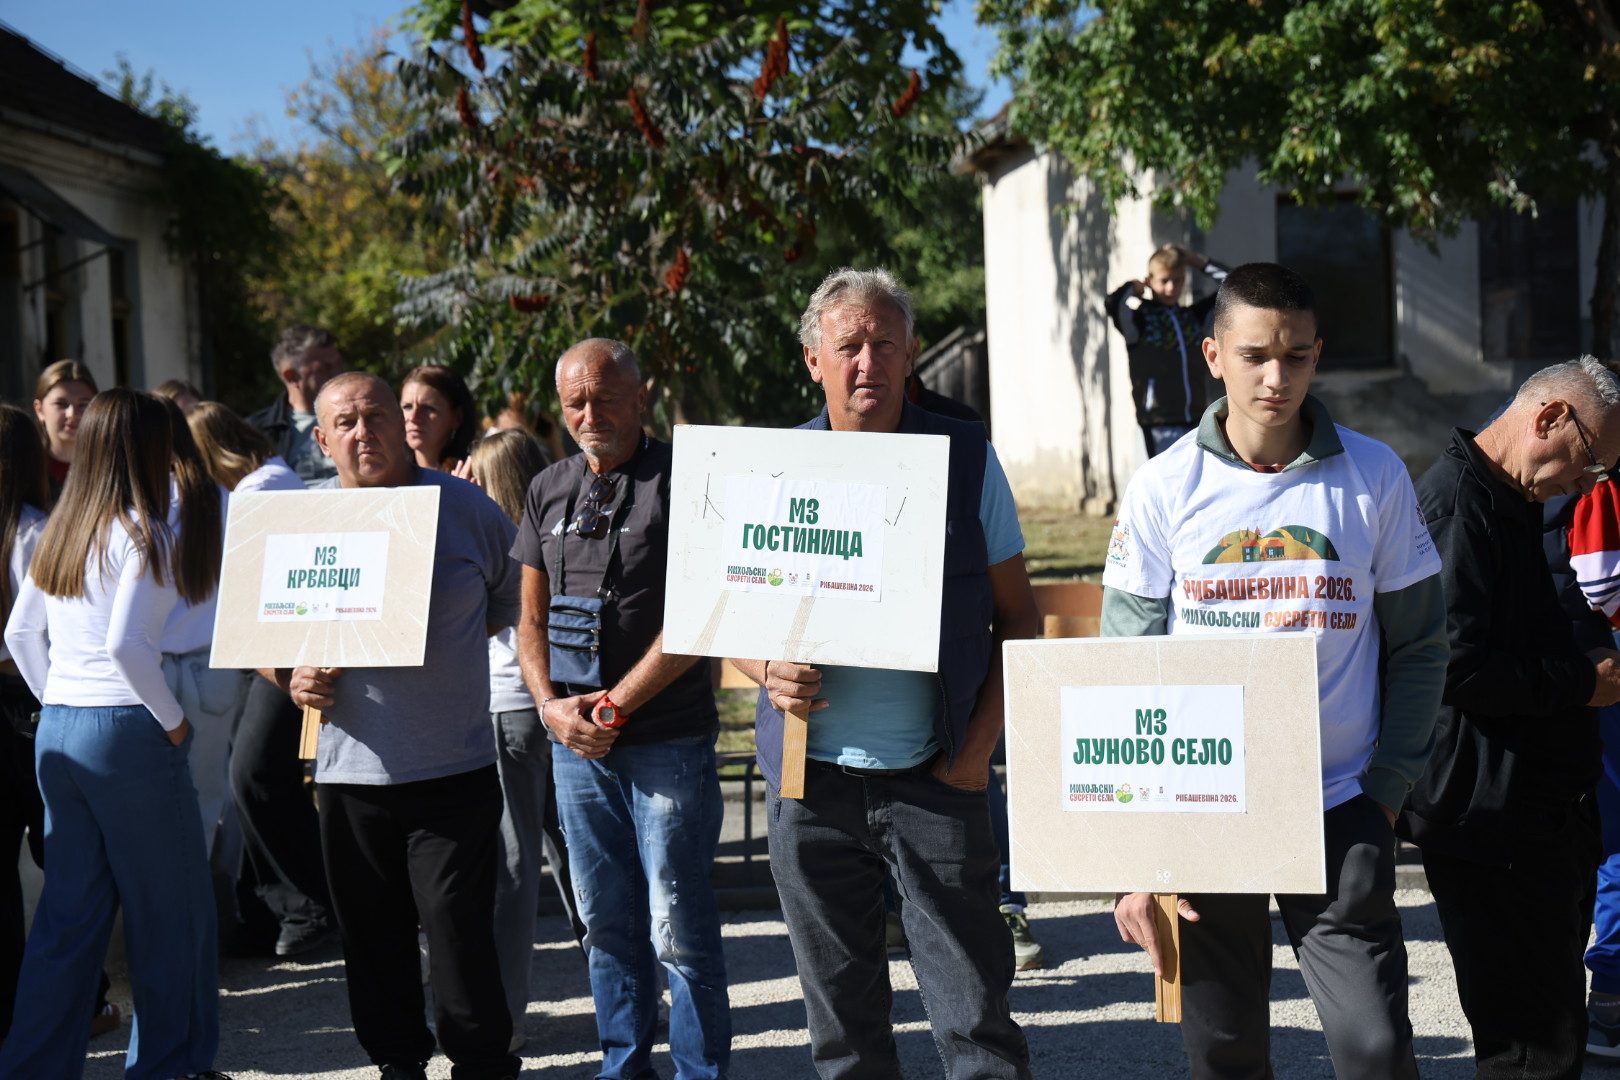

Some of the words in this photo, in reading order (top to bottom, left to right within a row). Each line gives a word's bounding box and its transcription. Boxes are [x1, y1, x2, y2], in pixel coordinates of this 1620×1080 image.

[789, 498, 819, 524] МЗ
[742, 524, 863, 560] ГОСТИНИЦА
[314, 546, 338, 566] МЗ
[287, 568, 361, 590] КРВАВЦИ
[727, 565, 767, 577] МИХОЉСКИ
[820, 580, 858, 591] РИБАШЕВИНА
[1183, 576, 1309, 602] РИБАШЕВИНА
[1314, 575, 1356, 602] 2026.
[1181, 607, 1260, 628] МИХОЉСКИ
[1263, 610, 1327, 628] СУСРЕТИ
[1330, 611, 1357, 629] СЕЛА
[1135, 708, 1167, 735] МЗ
[1073, 738, 1164, 765] ЛУНОВО
[1171, 738, 1233, 765] СЕЛО
[1069, 783, 1114, 794] МИХОЉСКИ
[1069, 794, 1097, 802] СУСРЕТИ
[1097, 794, 1114, 802] СЕЛА
[1175, 794, 1219, 803] РИБАШЕВИНА
[1220, 794, 1239, 803] 2026.
